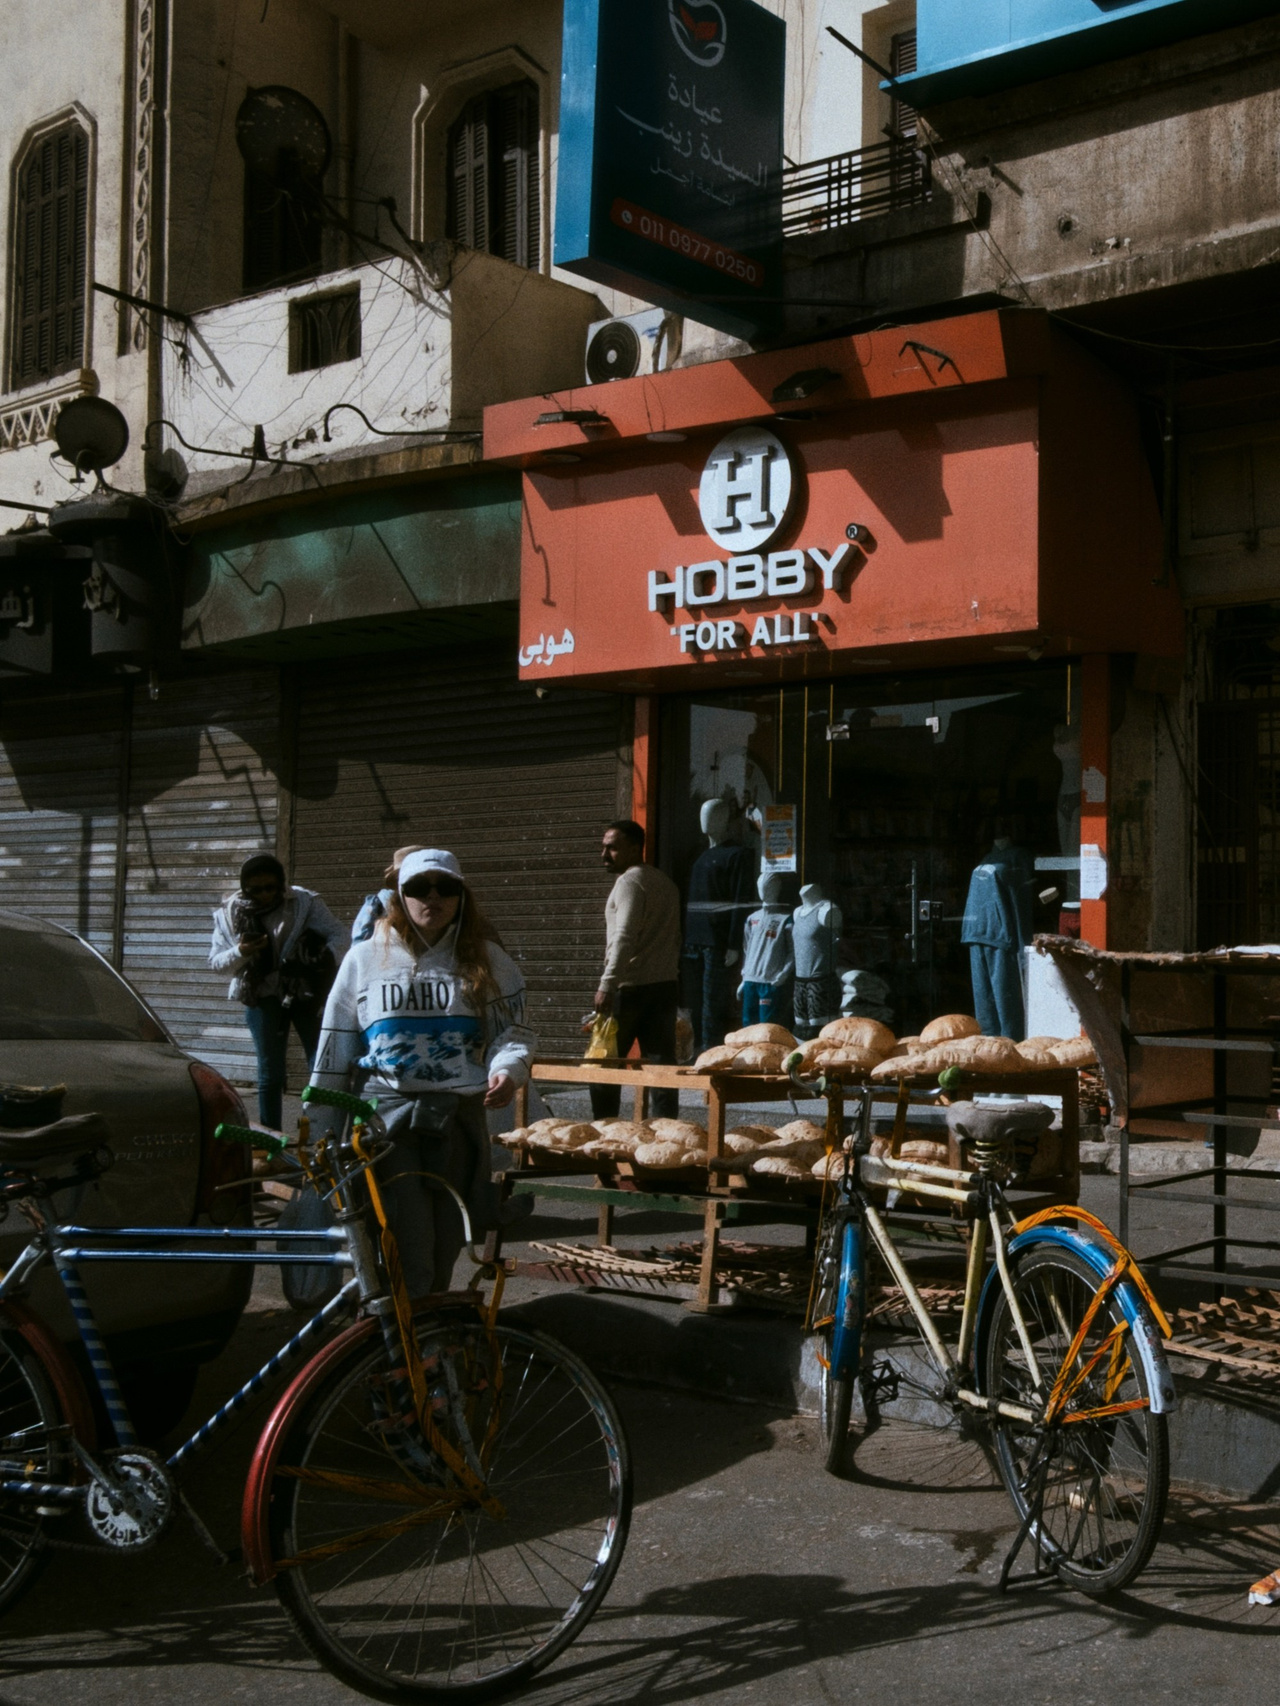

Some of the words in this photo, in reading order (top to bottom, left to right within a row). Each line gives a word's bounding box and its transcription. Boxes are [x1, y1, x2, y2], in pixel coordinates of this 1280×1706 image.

[668, 73, 723, 126] عيادة
[615, 104, 692, 158] زينب
[699, 131, 768, 189] السيدة
[640, 216, 664, 242] 011
[669, 229, 711, 261] 0977
[715, 251, 756, 282] 0250
[711, 453, 768, 529] H
[648, 543, 850, 612] HOBBY
[382, 980, 450, 1012] IDAHO
